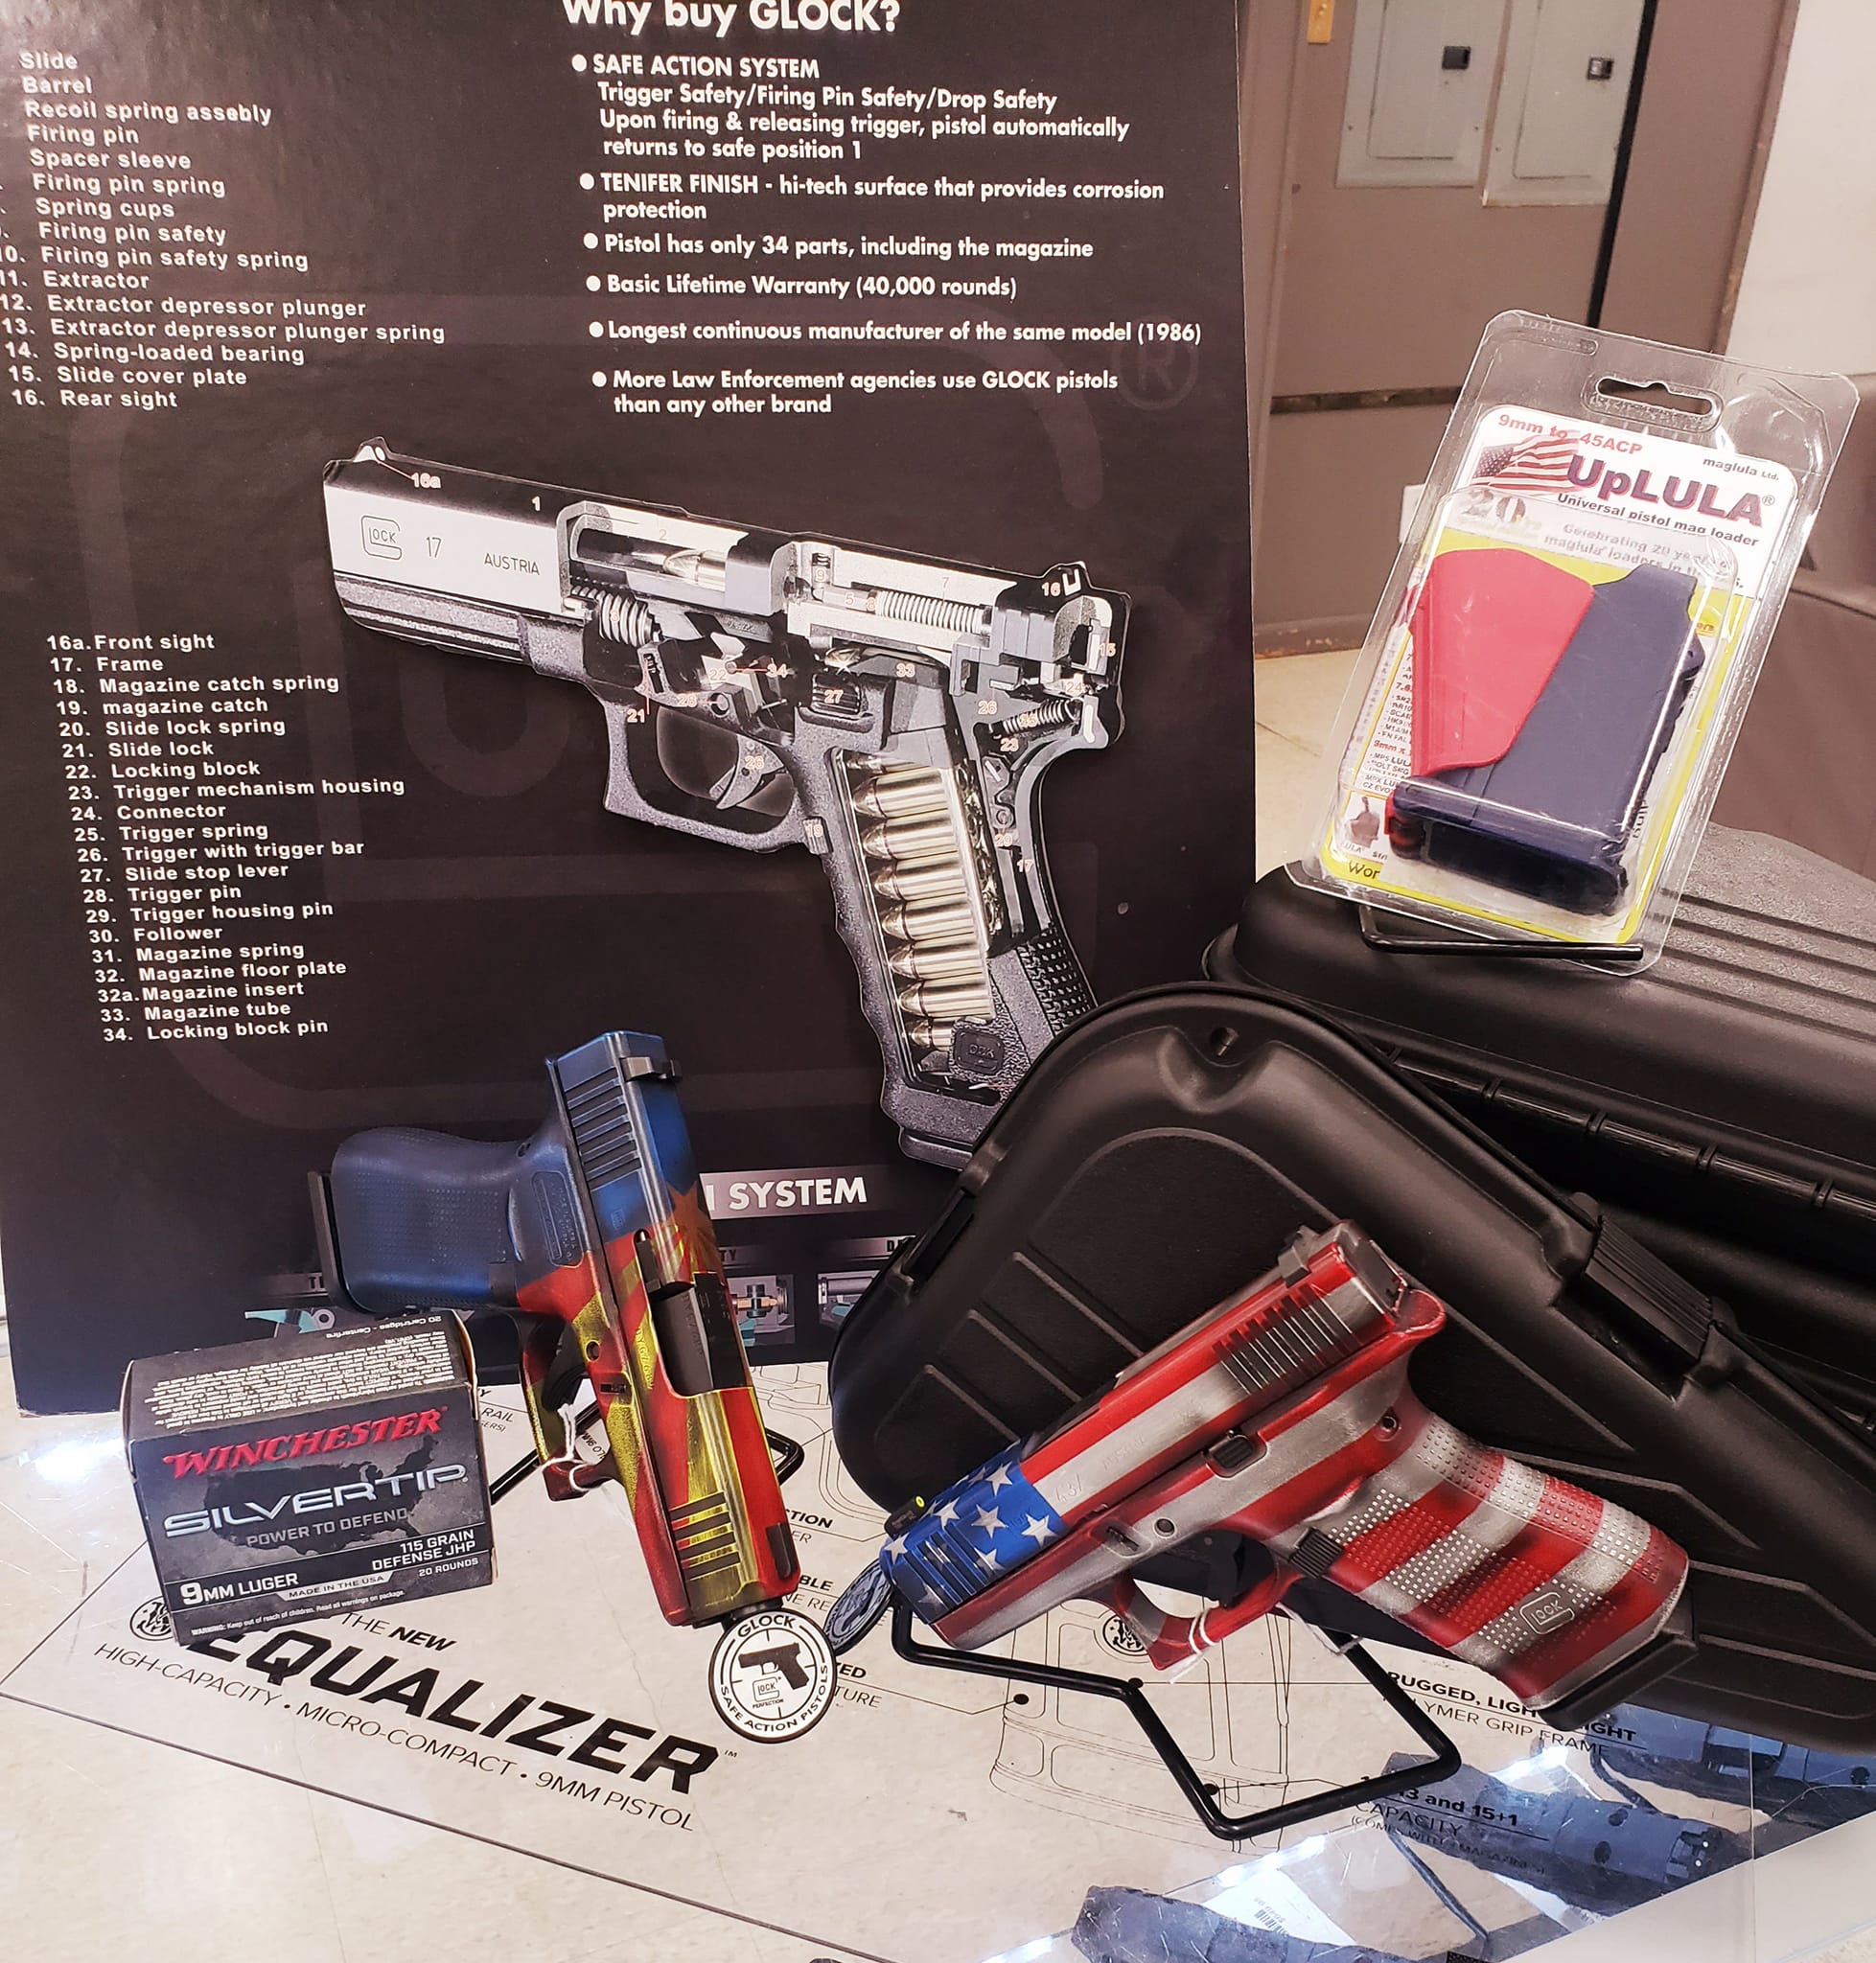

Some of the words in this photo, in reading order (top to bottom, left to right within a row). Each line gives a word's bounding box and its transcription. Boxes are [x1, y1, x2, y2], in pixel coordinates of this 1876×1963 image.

[562, 0, 653, 36] Why
[664, 0, 738, 38] buy
[749, 0, 900, 33] GLOCK?
[18, 51, 78, 70] Slide
[592, 53, 644, 75] SAFE
[650, 55, 732, 77] ACTION
[739, 57, 820, 79] SYSTEM
[20, 74, 92, 94] Barrel
[597, 80, 673, 107] Trigger
[679, 81, 816, 111] Safety/Firing
[822, 84, 854, 106] Pin
[861, 85, 987, 114] Safety/Drop
[993, 87, 1058, 115] Safety
[23, 97, 97, 119] Recoil
[104, 101, 179, 125] spring
[186, 104, 271, 127] assebly
[599, 108, 657, 134] Upon
[661, 107, 719, 136] firing
[726, 110, 743, 131] &
[749, 110, 845, 138] releasing
[850, 112, 925, 139] trigger,
[931, 114, 986, 140] pistol
[992, 116, 1130, 143] automatically
[29, 148, 110, 171] Spacer
[117, 150, 191, 170] sleeve
[604, 232, 660, 253] Pistol
[666, 232, 705, 254] has
[709, 233, 756, 260] only
[761, 235, 789, 255] 34
[795, 238, 855, 260] parts,
[861, 235, 952, 261] including
[958, 236, 990, 256] the
[996, 237, 1094, 262] magazine
[607, 273, 660, 293] Basic
[666, 272, 747, 294] Lifetime
[751, 275, 851, 300] Warranty
[856, 275, 936, 299] (40,000
[941, 275, 1017, 300] rounds)
[0, 293, 33, 312] 12.
[47, 293, 153, 312] Extractor
[161, 296, 274, 318] depressor
[282, 298, 366, 320] plunger
[1, 317, 35, 335] 13.
[50, 317, 156, 336] Extractor
[164, 320, 277, 341] depressor
[285, 322, 369, 343] plunger
[376, 324, 445, 344] spring
[12, 388, 45, 406] 16.
[59, 389, 113, 406] Rear
[120, 390, 178, 411] sight
[614, 393, 660, 413] than
[666, 399, 706, 418] any
[711, 393, 766, 413] other
[771, 393, 832, 413] brand
[1498, 414, 1543, 436] 9mm
[1549, 425, 1567, 439] to
[1702, 457, 1757, 476] maglula
[1557, 493, 1625, 518] Universal
[1629, 510, 1671, 528] pistol
[1675, 520, 1707, 535] mag
[1710, 527, 1760, 547] loader
[426, 536, 442, 559] 17
[484, 552, 540, 576] AUSTRIA
[1041, 583, 1061, 597] 16
[46, 635, 92, 651] 16a.
[94, 635, 153, 650] Front
[159, 634, 215, 653] sight
[53, 679, 85, 694] 18.
[99, 677, 200, 697] Magazine
[207, 676, 265, 692] catch
[272, 675, 339, 694] spring
[68, 785, 100, 800] 23.
[112, 784, 190, 802] Trigger
[197, 780, 315, 797] mechanism
[321, 778, 405, 796] housing
[77, 847, 108, 863] 26.
[121, 845, 197, 864] Trigger
[203, 843, 248, 859] with
[254, 842, 325, 860] trigger
[331, 841, 364, 855] bar
[103, 1027, 133, 1042] 34.
[147, 1024, 228, 1040] Locking
[235, 1020, 290, 1036] block
[297, 1019, 329, 1037] pin
[730, 1176, 868, 1210] SYSTEM
[481, 1407, 514, 1423] RAIL
[162, 1412, 442, 1480] WINCHESTER
[164, 1463, 468, 1539] SILVERTIP
[246, 1525, 311, 1548] POWER
[316, 1522, 336, 1536] TO
[340, 1508, 408, 1530] DEFEND
[400, 1536, 423, 1554] 115
[428, 1528, 475, 1548] GRAIN
[372, 1548, 444, 1571] DEFENSE
[449, 1540, 476, 1558] JHP
[419, 1566, 432, 1577] 20
[435, 1558, 478, 1573] ROUNDS
[180, 1582, 234, 1605] 9MM
[240, 1573, 299, 1595] LUGER
[289, 1587, 320, 1598] MADE
[337, 1580, 359, 1589] THE
[362, 1575, 384, 1583] USA
[340, 1612, 391, 1635] THE
[388, 1626, 457, 1651] NEW
[738, 1615, 796, 1638] GLOCK
[720, 1685, 744, 1723] SAFE
[801, 1664, 828, 1722] PISTOLS
[94, 1642, 280, 1709] HIGH-CAPACITY
[297, 1701, 518, 1776] MICRO-COMPACT
[535, 1770, 602, 1804] 9MM
[604, 1790, 696, 1832] PISTOL
[745, 1718, 799, 1733] ACTION
[1485, 1717, 1534, 1738] GRIP
[1539, 1728, 1613, 1757] FRAME
[1355, 1801, 1464, 1836] CAPACITY
[1424, 1795, 1465, 1813] and
[1471, 1805, 1518, 1827] 15+1
